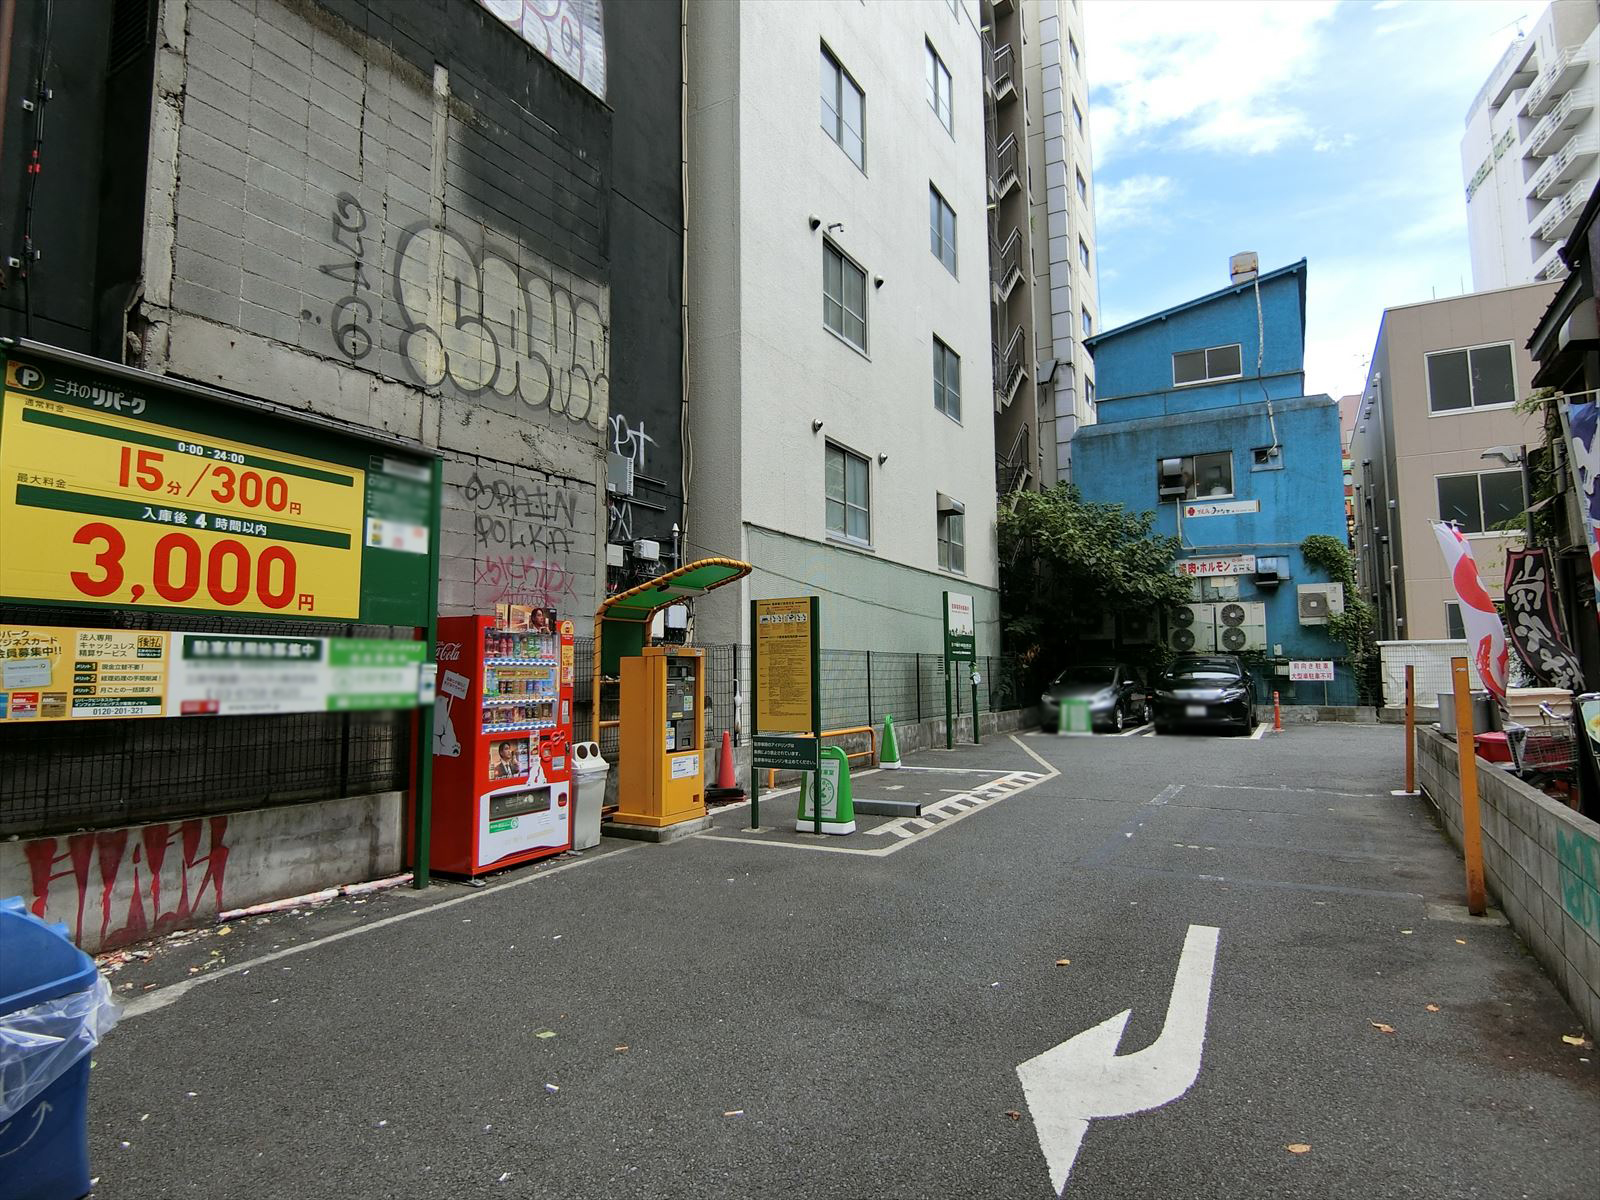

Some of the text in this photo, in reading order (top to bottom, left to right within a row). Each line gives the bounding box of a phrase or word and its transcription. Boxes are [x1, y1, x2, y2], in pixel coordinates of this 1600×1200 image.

[54, 378, 146, 415] 三井のリパーク
[25, 397, 65, 413] 通常料金
[17, 472, 67, 489] 最大料金
[79, 633, 113, 642] 法人専用
[79, 642, 136, 650] キャッシュレス
[79, 649, 127, 657] 精算サービス
[92, 707, 144, 716] 0120-201-321
